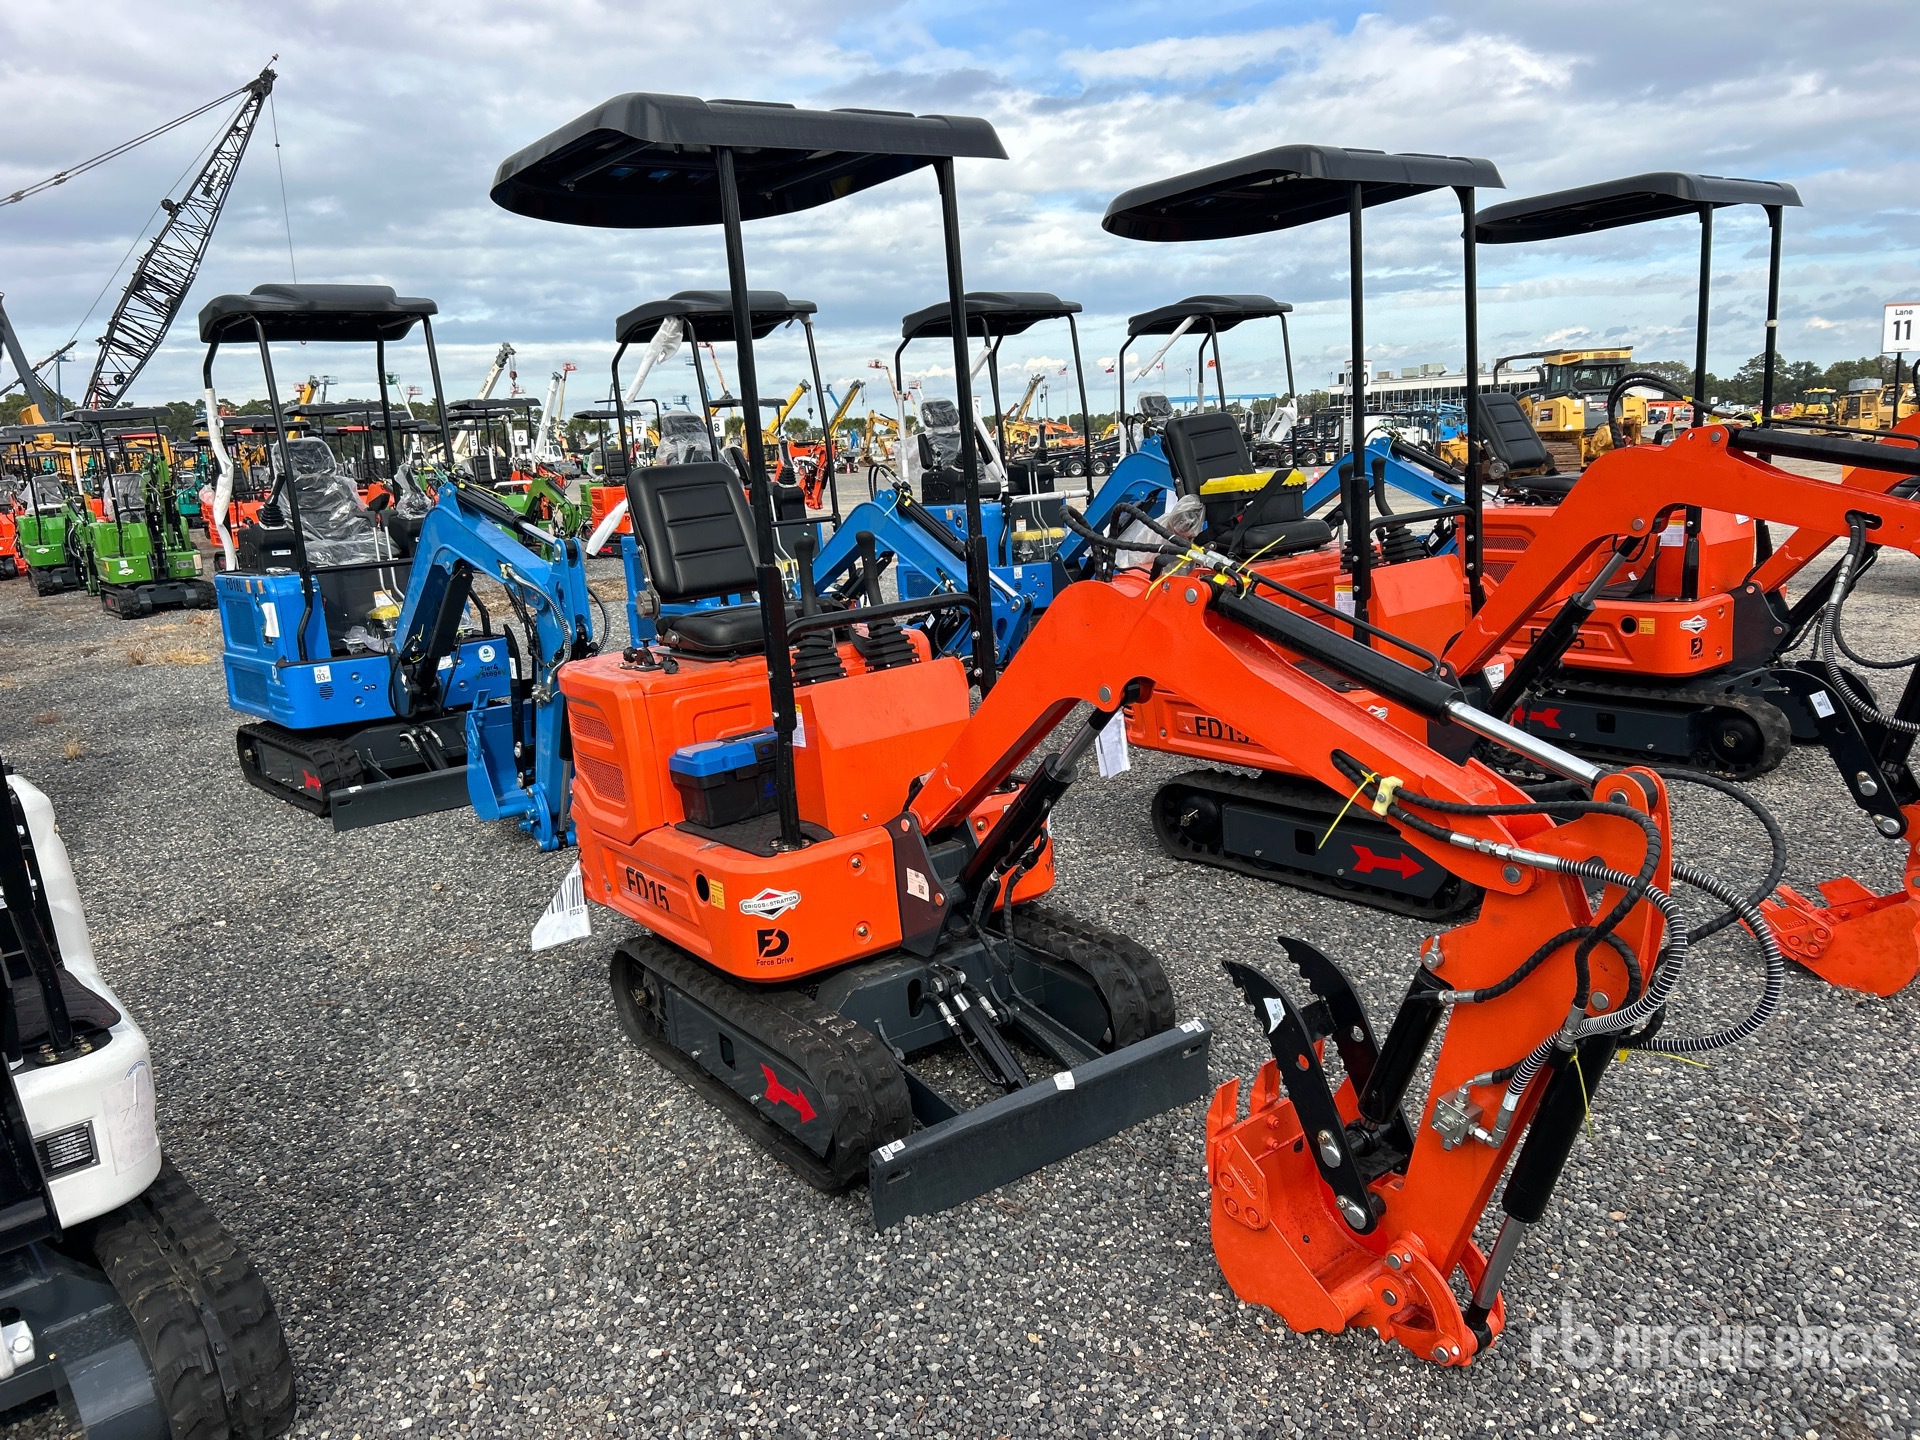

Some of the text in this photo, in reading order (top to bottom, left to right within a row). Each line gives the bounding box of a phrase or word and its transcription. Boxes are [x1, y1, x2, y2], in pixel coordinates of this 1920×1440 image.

[1893, 319, 1912, 340] 11
[636, 426, 642, 434] 7
[714, 423, 720, 432] 8
[1530, 628, 1585, 650] F5
[625, 865, 670, 914] FD15
[569, 906, 584, 917] FD15
[756, 956, 794, 966] Force Drive
